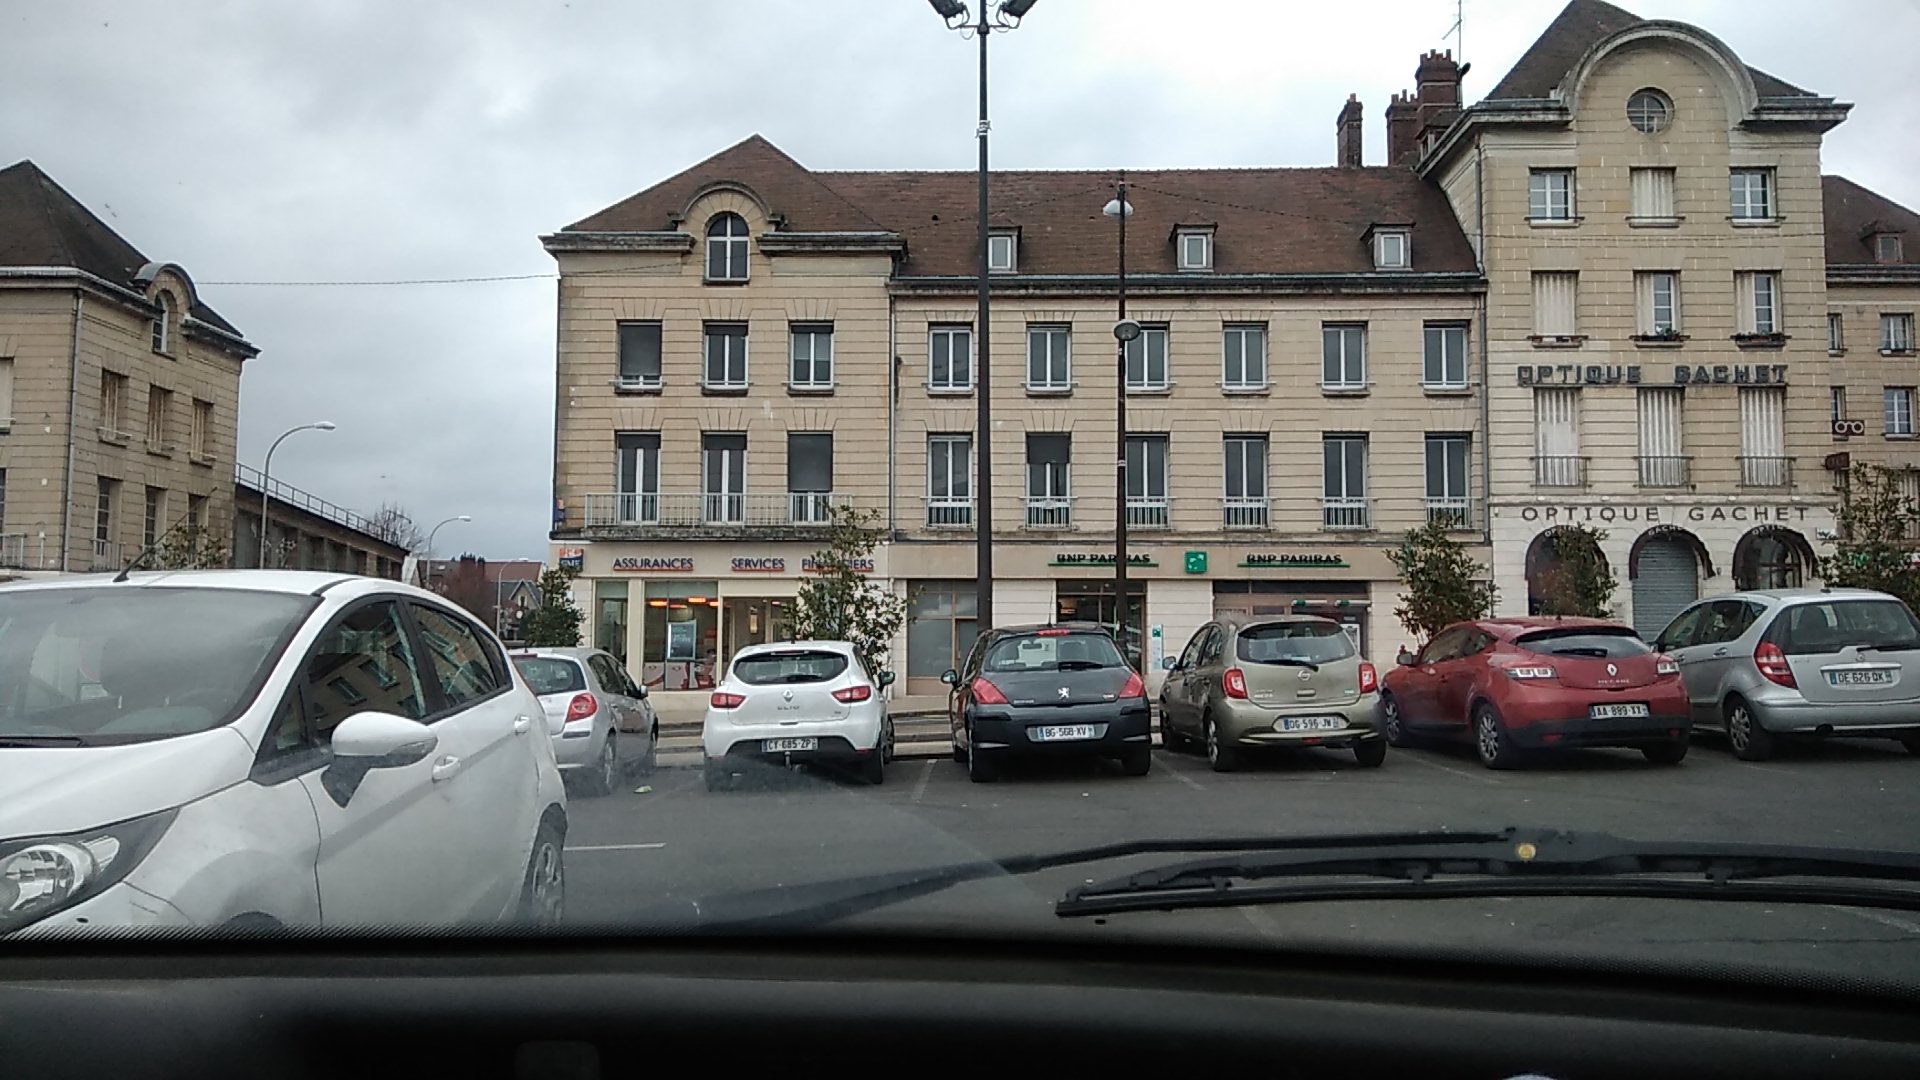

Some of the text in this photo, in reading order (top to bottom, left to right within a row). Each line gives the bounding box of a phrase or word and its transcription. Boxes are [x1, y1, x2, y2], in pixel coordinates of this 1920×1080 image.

[1517, 364, 1788, 385] OPTIQUE GACHET
[1522, 506, 1809, 523] OPTIQUE GACHET
[613, 557, 693, 570] ASSURANCES
[732, 558, 785, 569] SERVICES
[1057, 554, 1150, 562] BNP PARBAS
[1246, 554, 1342, 563] BNP PARIBAS
